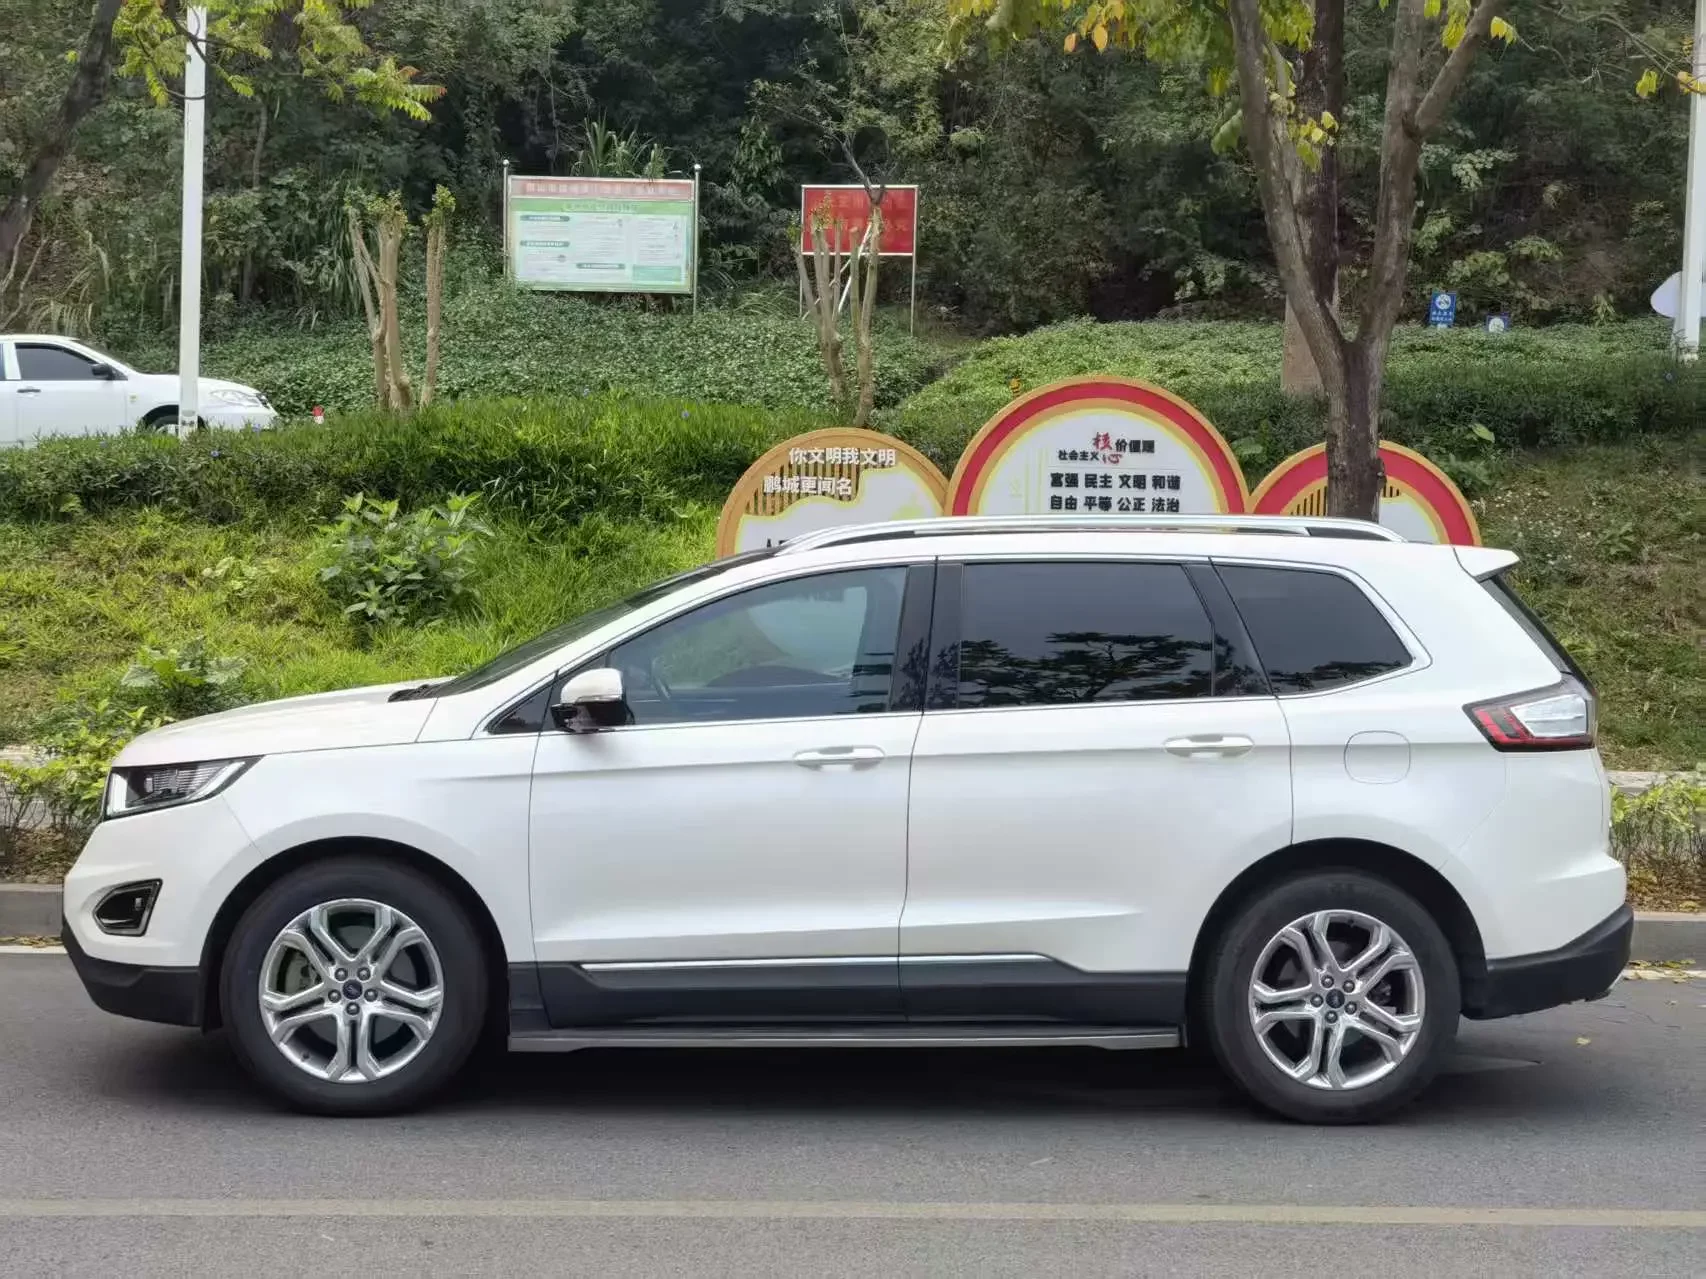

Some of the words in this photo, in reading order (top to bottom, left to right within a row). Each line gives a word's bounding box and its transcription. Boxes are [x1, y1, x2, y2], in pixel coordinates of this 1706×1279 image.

[788, 447, 896, 466] 你文明我文明
[1058, 450, 1099, 461] 社会主义
[763, 475, 852, 496] 鹏城更闻名
[1050, 472, 1079, 488] 富强
[1085, 473, 1112, 489] 民主
[1118, 474, 1147, 490] 文明
[1152, 475, 1181, 491] 和谐
[1050, 495, 1078, 510] 自由
[1083, 496, 1112, 511] 平等
[1117, 497, 1146, 512] 公正
[1151, 497, 1180, 512] 法治
